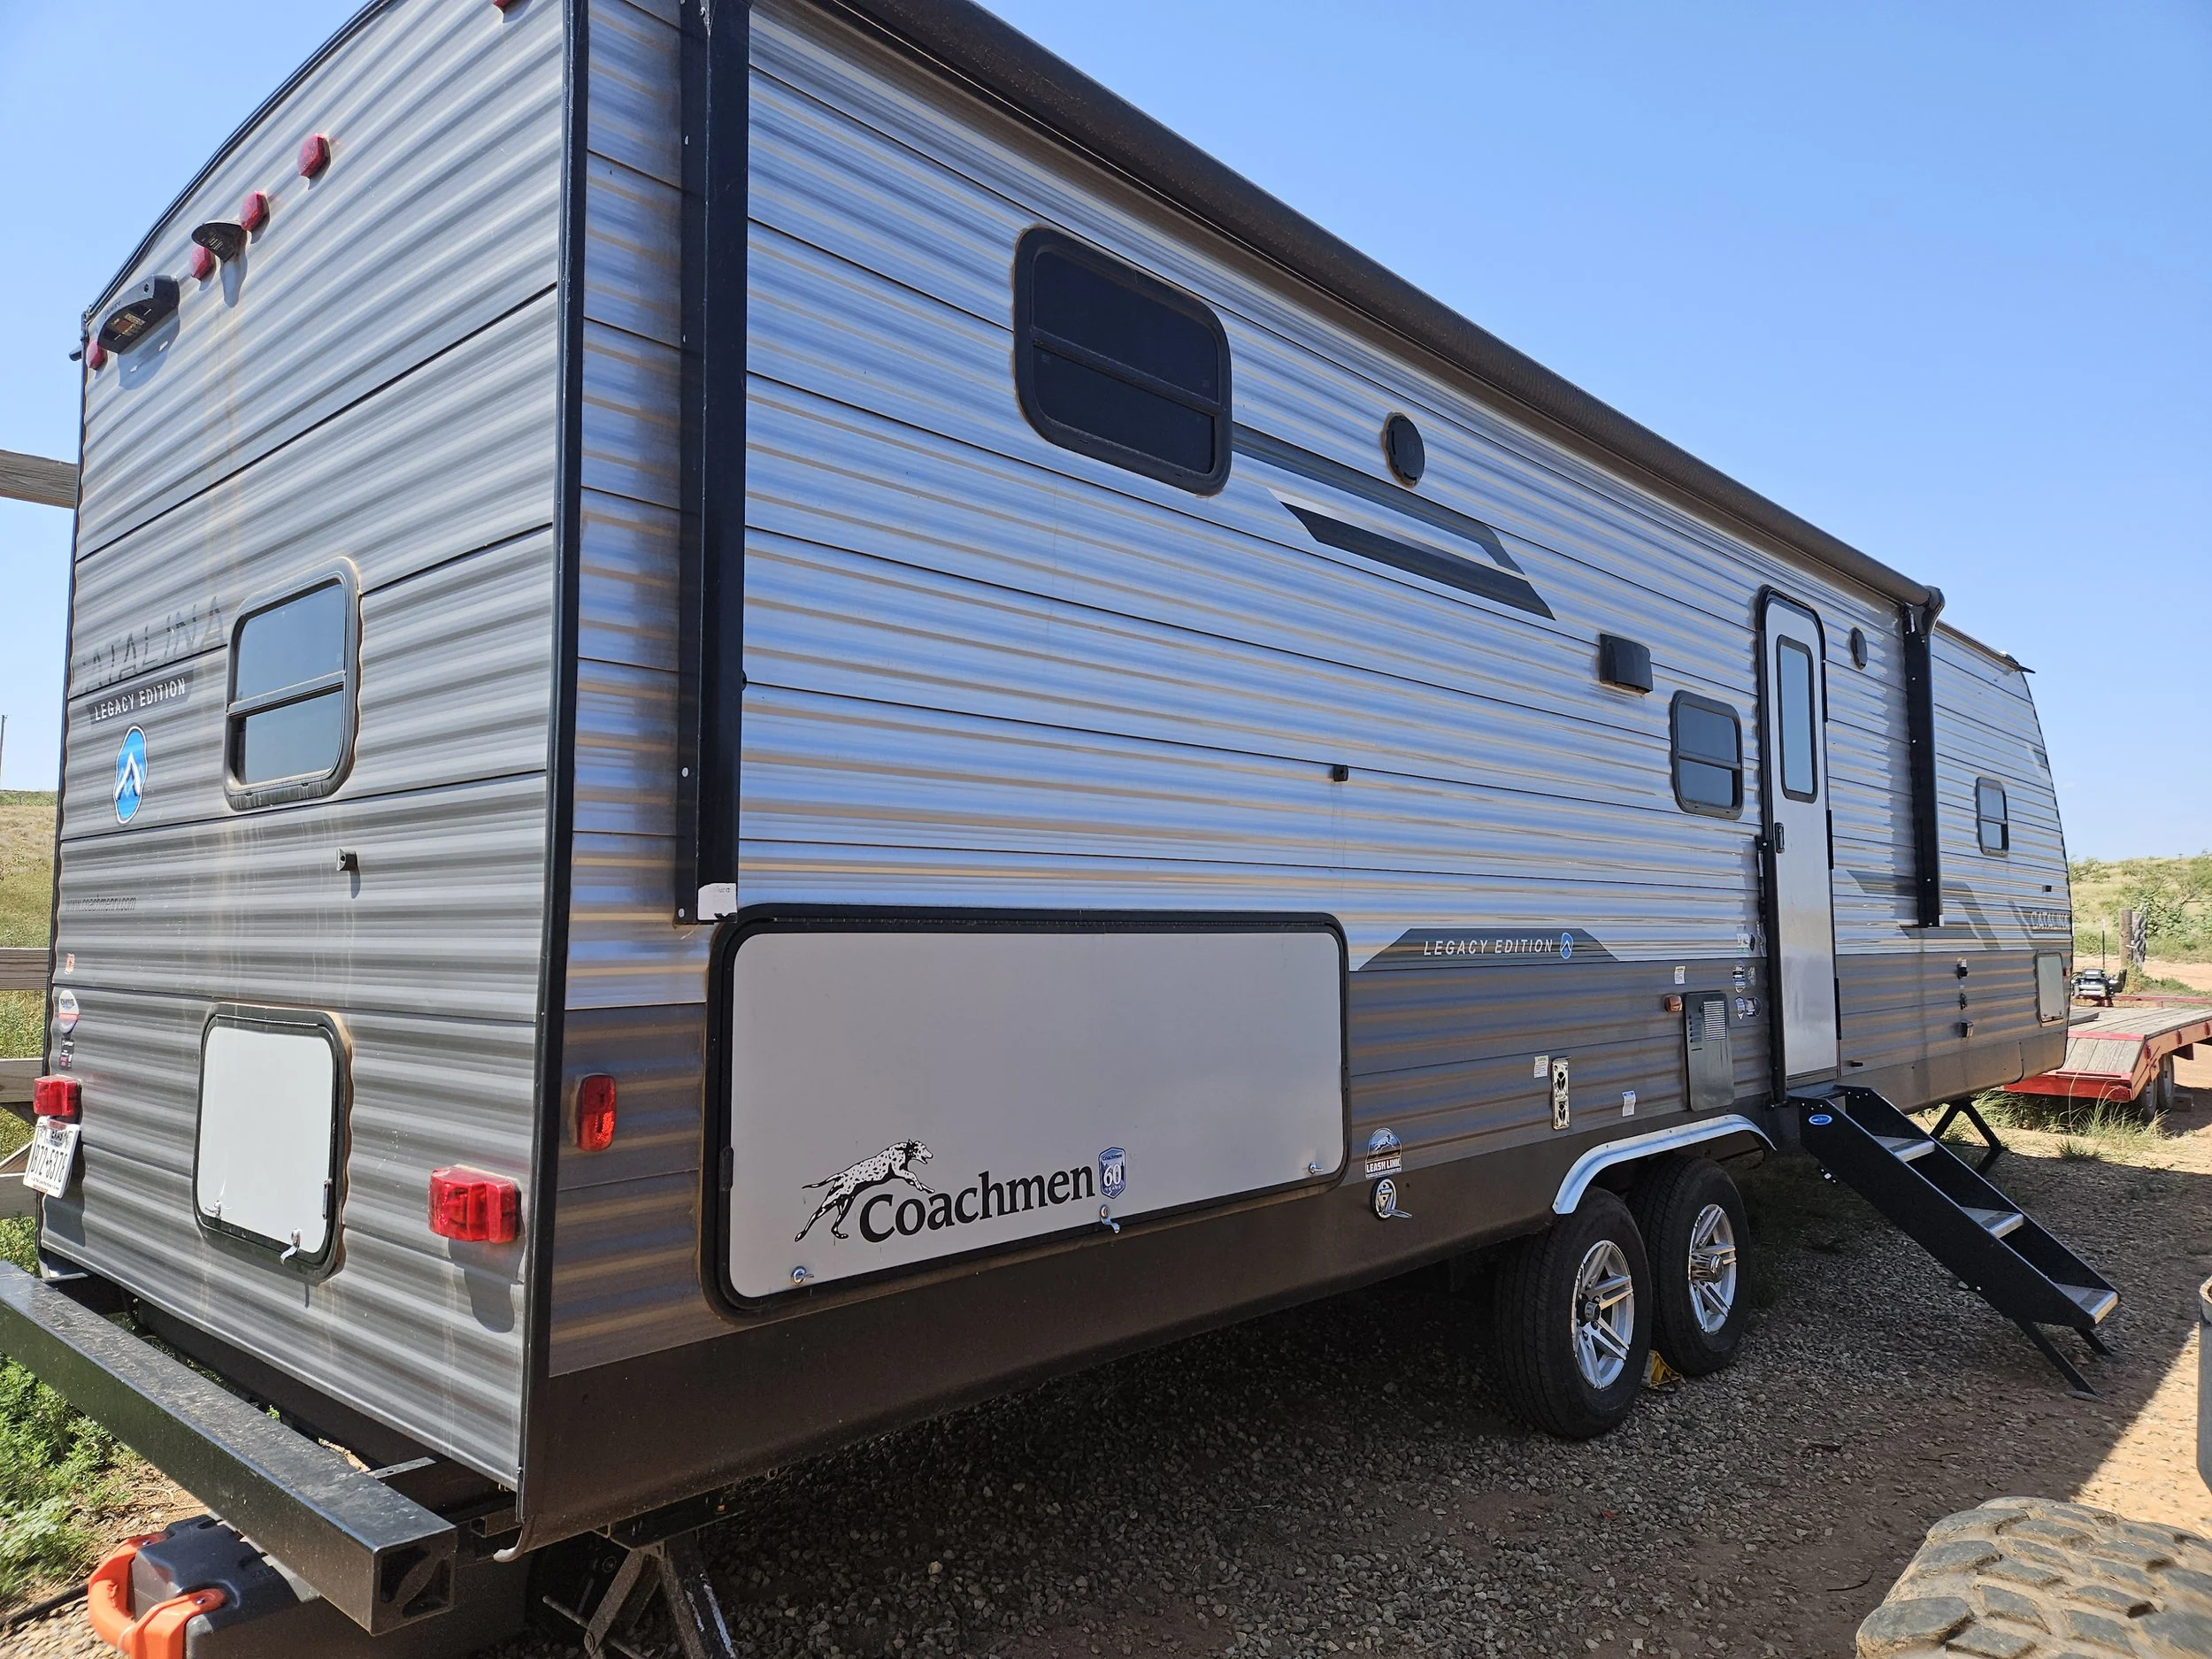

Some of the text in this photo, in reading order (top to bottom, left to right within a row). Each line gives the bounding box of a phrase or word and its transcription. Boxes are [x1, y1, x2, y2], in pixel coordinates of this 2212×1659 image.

[76, 595, 225, 692] ATALINA
[94, 678, 185, 721] LEGACY EDITION
[1424, 938, 1553, 956] LEGACY EDITION
[1103, 1164, 1122, 1187] 60
[1366, 1160, 1386, 1173] LEASH
[1386, 1157, 1402, 1170] LINK
[859, 1165, 1095, 1243] Coachmen
